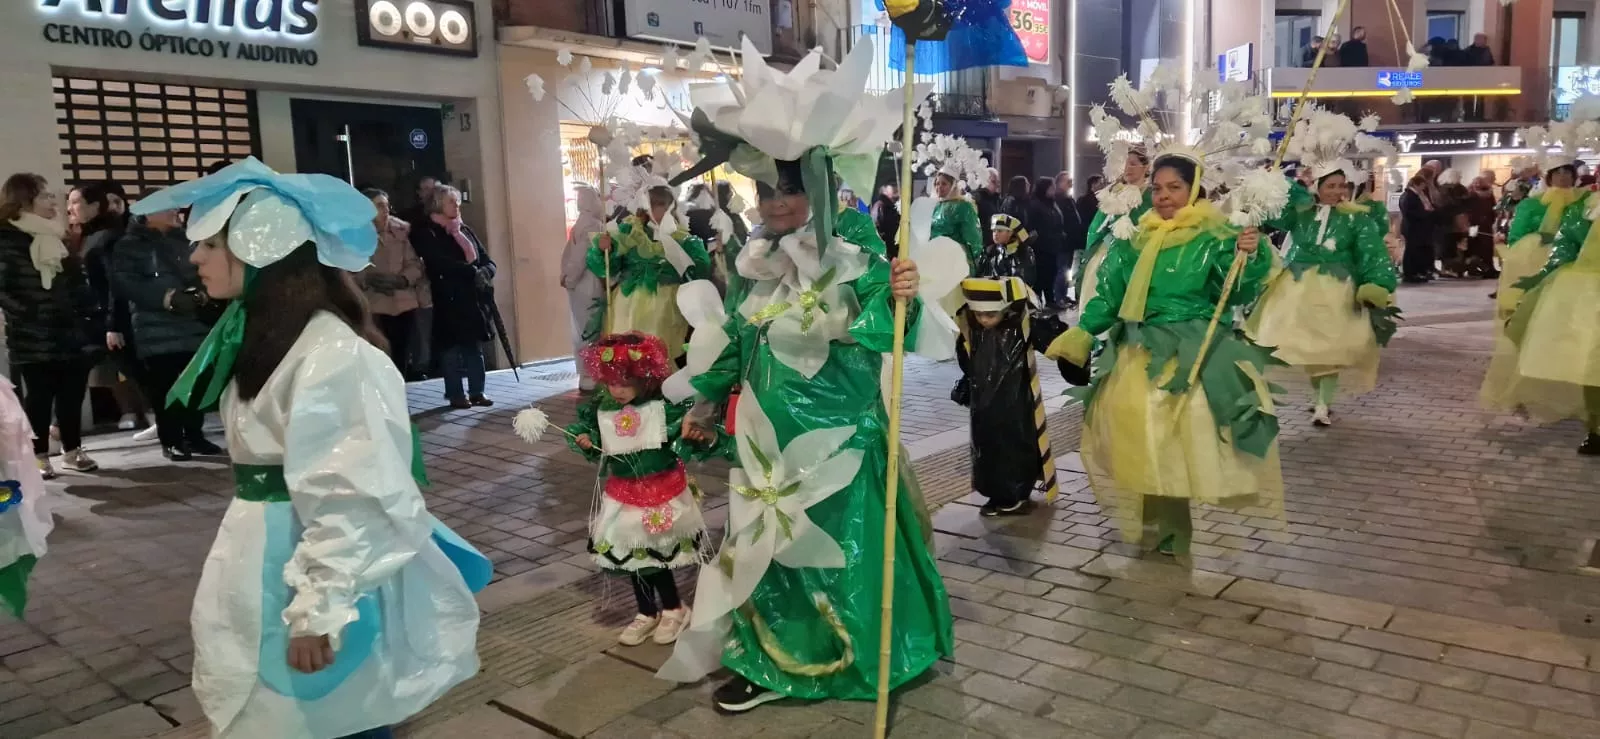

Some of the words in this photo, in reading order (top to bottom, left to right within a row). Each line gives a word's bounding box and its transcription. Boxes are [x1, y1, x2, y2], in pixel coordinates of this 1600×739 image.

[41, 0, 318, 35] enas
[1012, 9, 1033, 31] 36
[43, 22, 133, 49] CENTRO
[139, 27, 214, 57] ÓPTICO
[218, 41, 230, 58] Y
[237, 42, 318, 66] AUDITIVO
[1392, 72, 1422, 80] REALE
[460, 112, 472, 132] 13
[1478, 131, 1502, 148] EL
